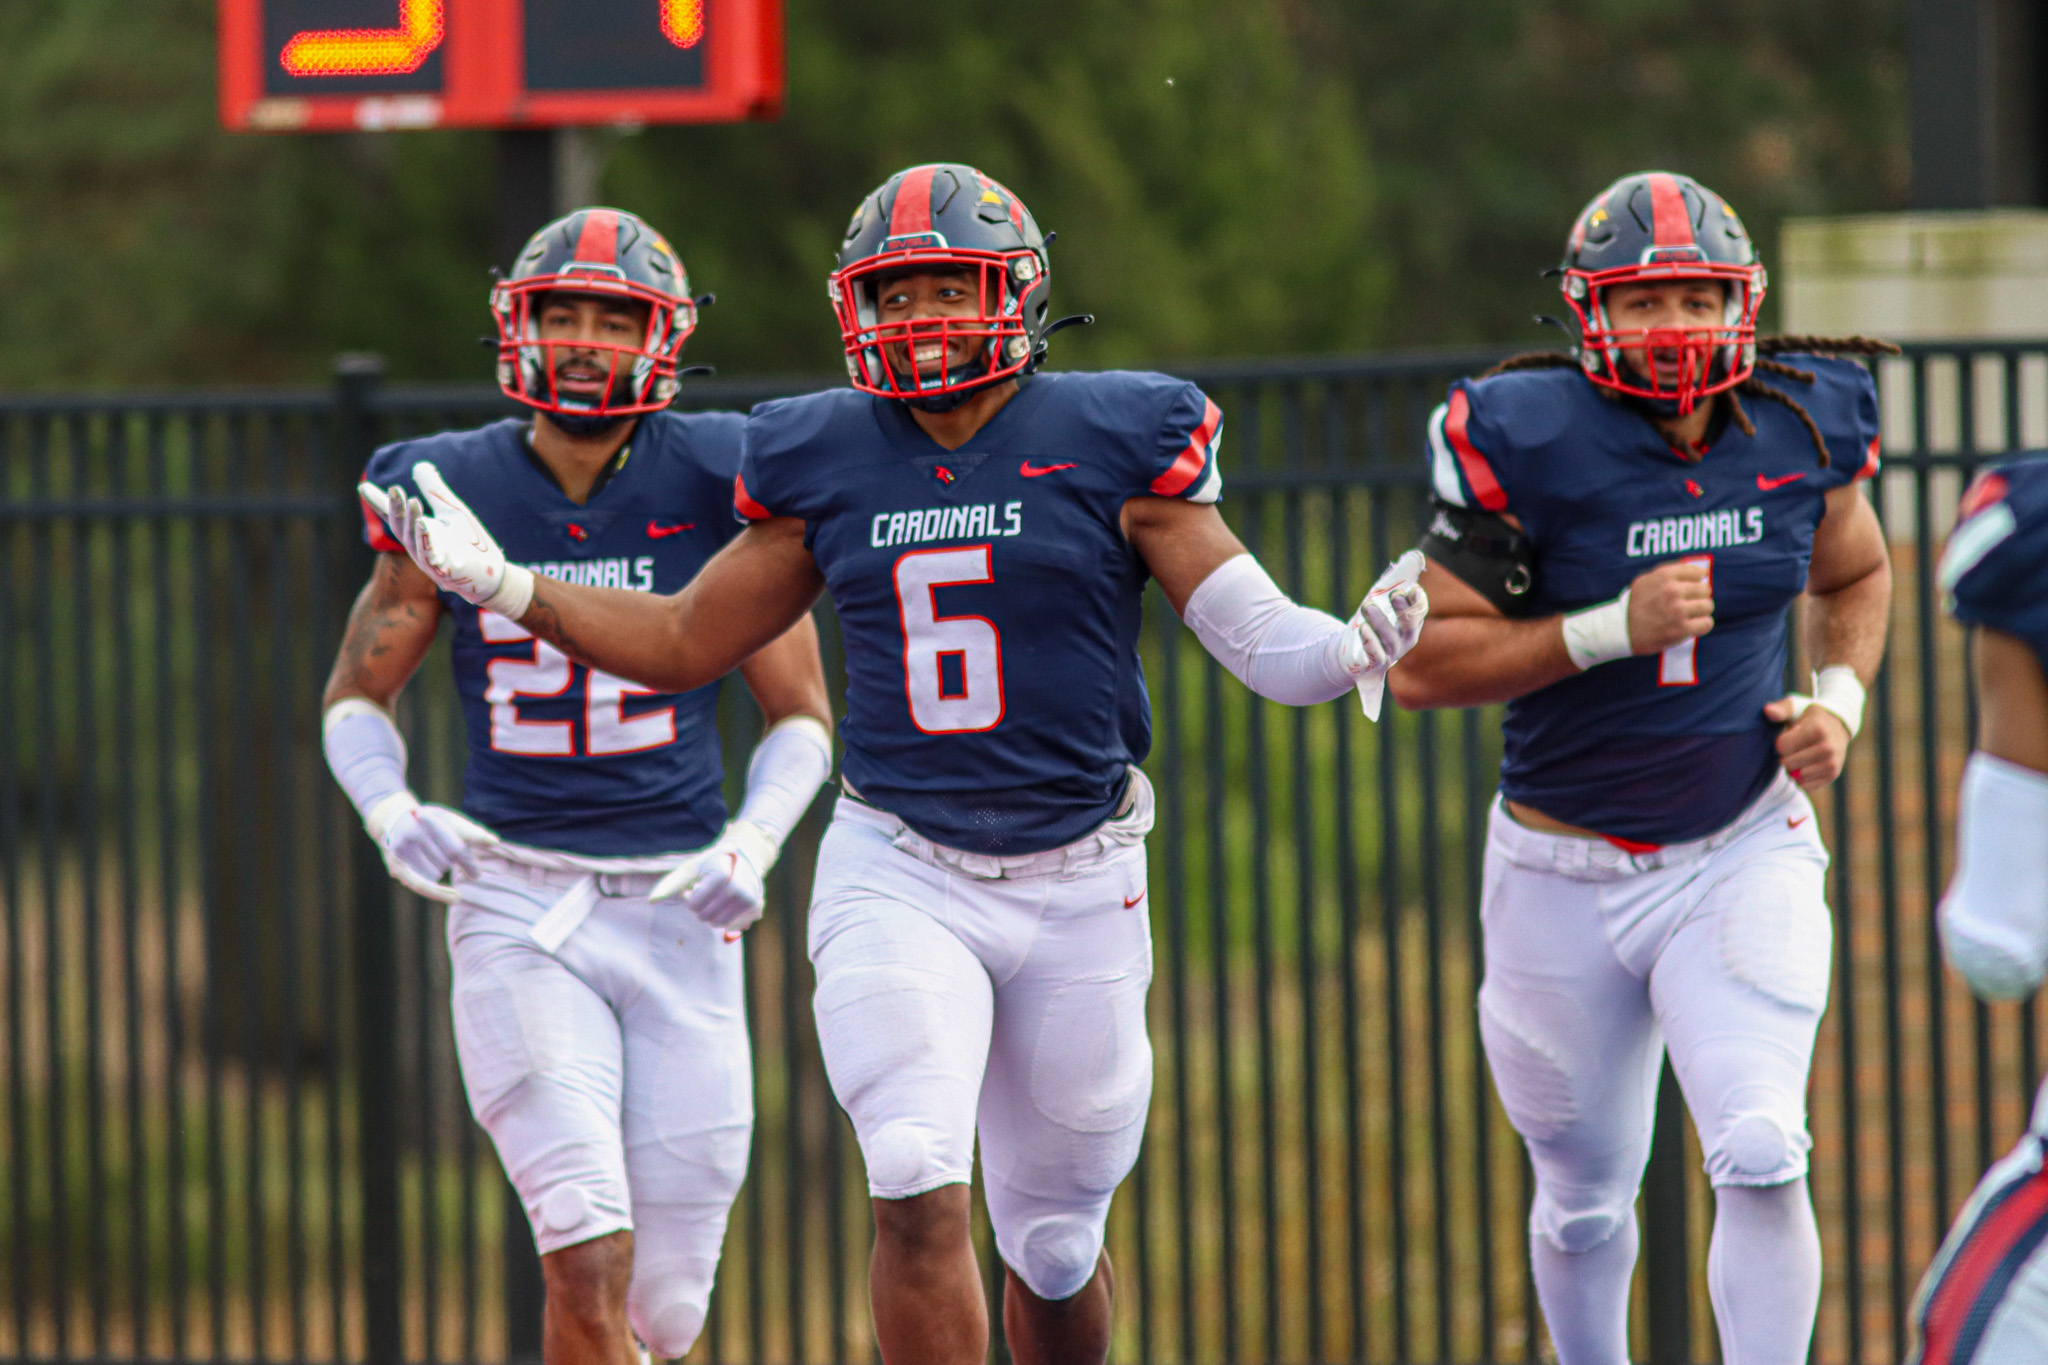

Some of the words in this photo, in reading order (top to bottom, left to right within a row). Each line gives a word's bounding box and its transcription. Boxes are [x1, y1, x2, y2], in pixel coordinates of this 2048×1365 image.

[869, 501, 1022, 547] CARDINALS
[1626, 507, 1764, 557] CARDINALS
[478, 608, 676, 757] 22
[892, 543, 1005, 735] 6
